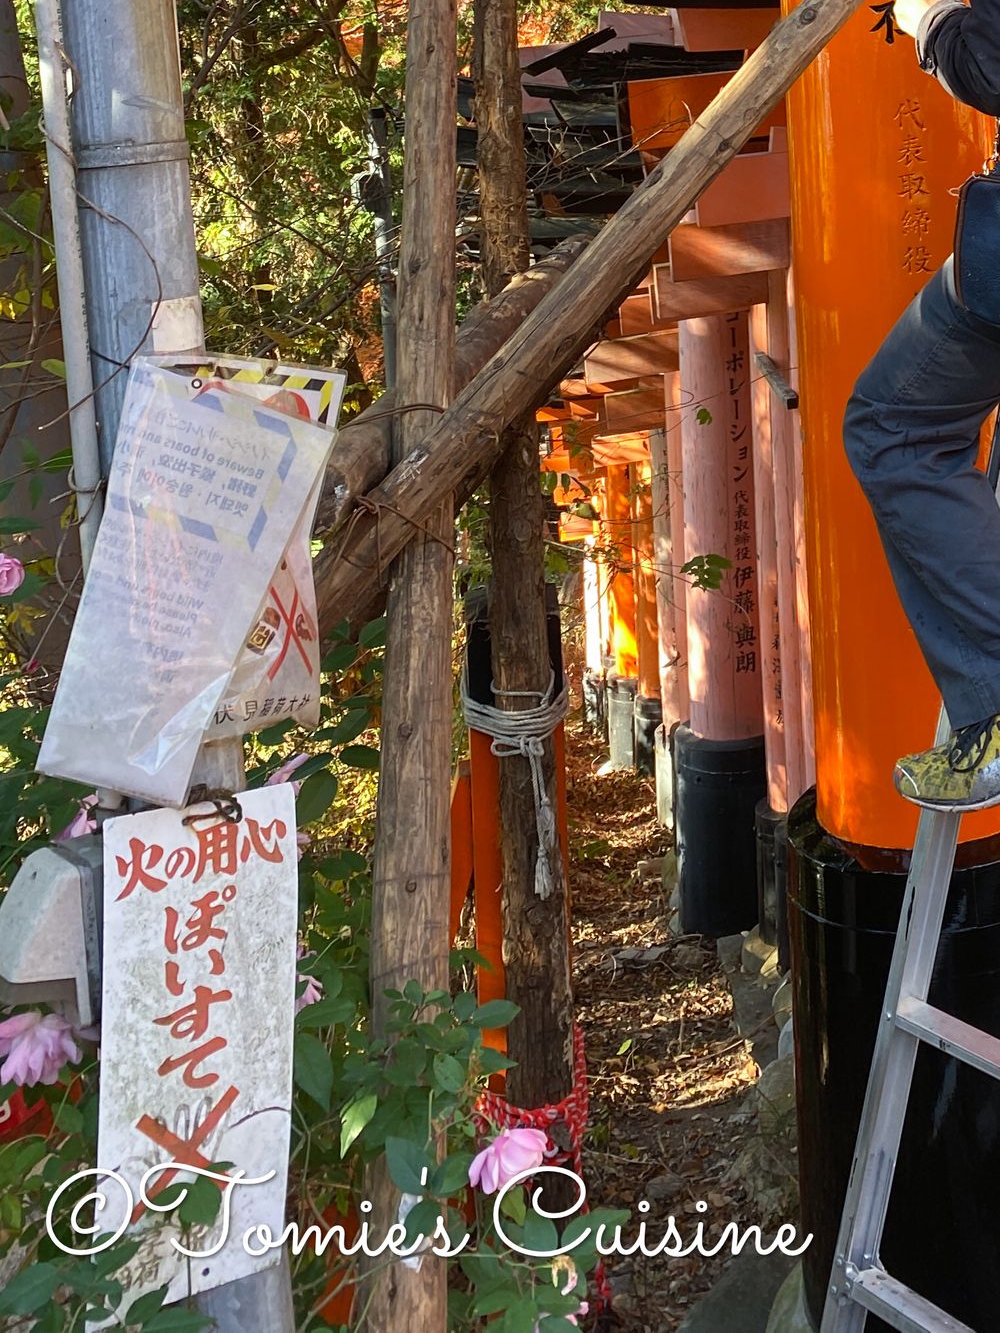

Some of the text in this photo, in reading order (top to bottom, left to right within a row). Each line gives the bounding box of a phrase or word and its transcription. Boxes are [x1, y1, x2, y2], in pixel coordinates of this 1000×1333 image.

[115, 818, 287, 902] 火の用心
[152, 884, 237, 1089] ぽいすて
